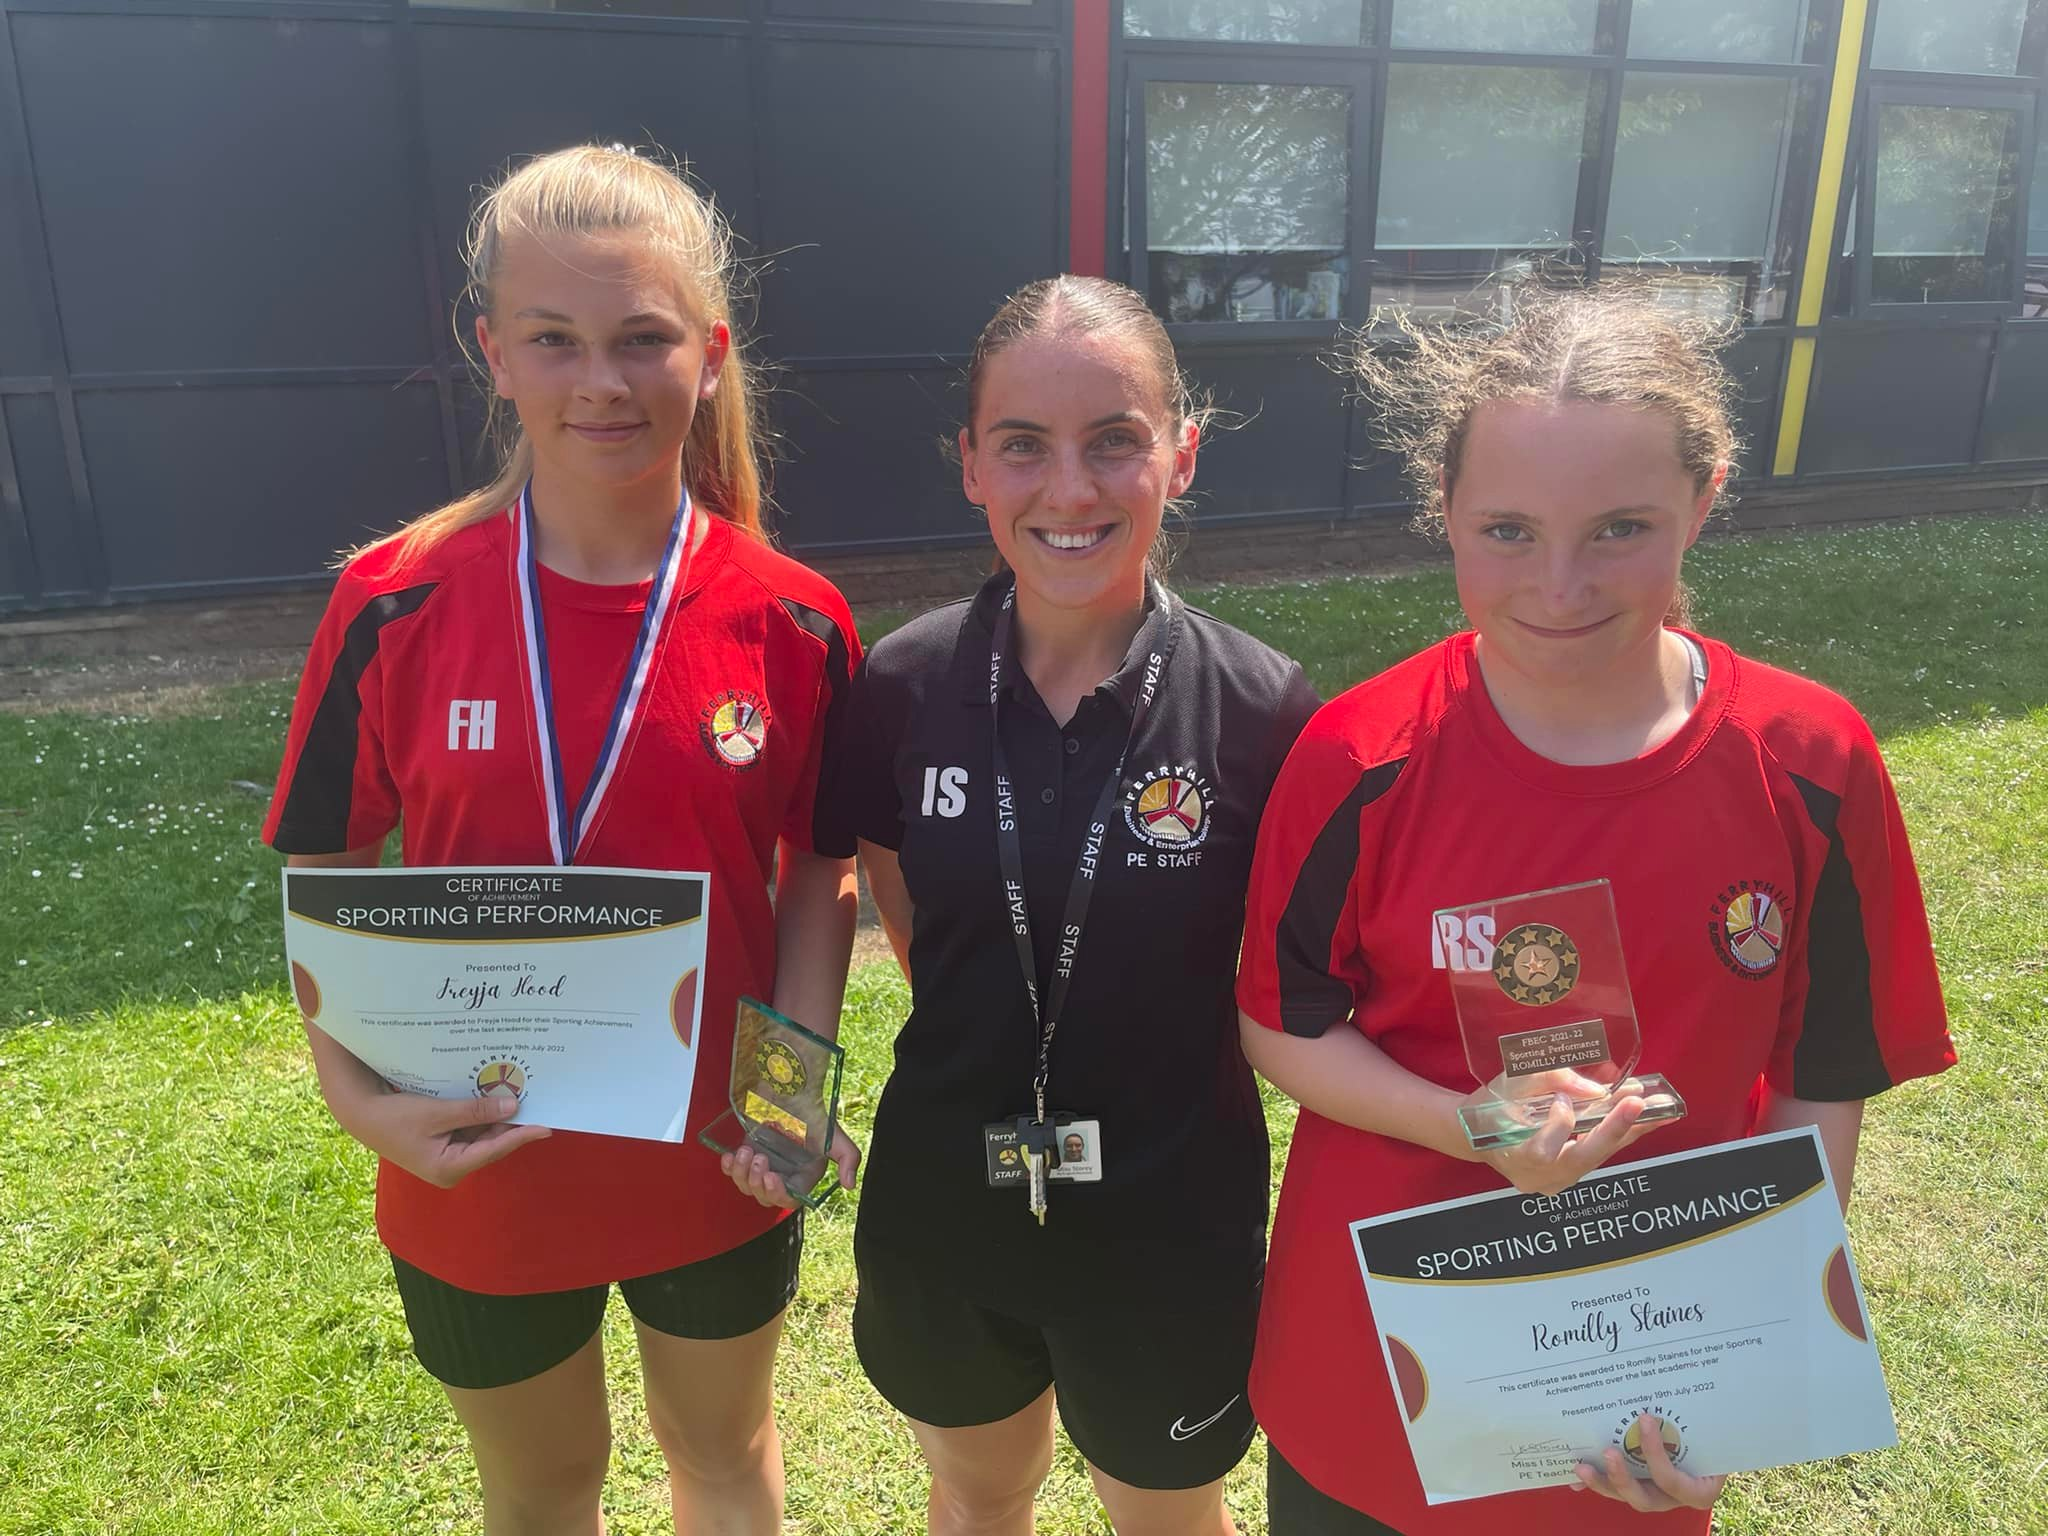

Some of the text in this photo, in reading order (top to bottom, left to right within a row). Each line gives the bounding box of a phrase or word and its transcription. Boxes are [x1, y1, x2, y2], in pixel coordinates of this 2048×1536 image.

[989, 651, 1001, 704] STAFF
[1142, 652, 1161, 707] STAFF
[447, 699, 497, 751] FH
[921, 766, 969, 818] IS
[997, 775, 1014, 831] STAFF
[1126, 765, 1215, 811] FERRYHILL
[1080, 821, 1105, 880] STAFF
[1127, 851, 1203, 868] PE STAFF
[446, 878, 563, 893] CERTIFICATE
[467, 893, 541, 902] OF ACHIEVEMENT
[336, 904, 663, 928] SPORTING PERFORMANCE
[1006, 879, 1028, 935] STAFF
[1057, 924, 1080, 979] STAFF
[1432, 914, 1497, 971] RS
[465, 962, 537, 973] Presented To
[510, 974, 568, 998] Hood
[1510, 1039, 1601, 1061] Sporting Performance
[1512, 1049, 1601, 1072] ROMILLY STAINES
[989, 1131, 1017, 1141] Ferry
[994, 1170, 1022, 1179] STAFF
[1521, 1174, 1651, 1217] CERTIFICATE
[1549, 1199, 1630, 1224] OF ACHIEVEMENT
[1416, 1184, 1781, 1278] SPORTING PERFORMANCE
[1571, 1286, 1650, 1311] Presented To
[1532, 1302, 1706, 1352] Romilly Staines
[1499, 1335, 1763, 1393] This certificate was awarded to Romilly Staines for their Sporting
[1545, 1356, 1719, 1397] Achievements over the last academic year
[1561, 1380, 1715, 1417] Presented on Tuesday 19th July 2022
[1612, 1406, 1688, 1445] FERRYHILL
[1511, 1460, 1537, 1469] Miss
[1546, 1457, 1583, 1468] Storey
[1519, 1471, 1533, 1480] PE
